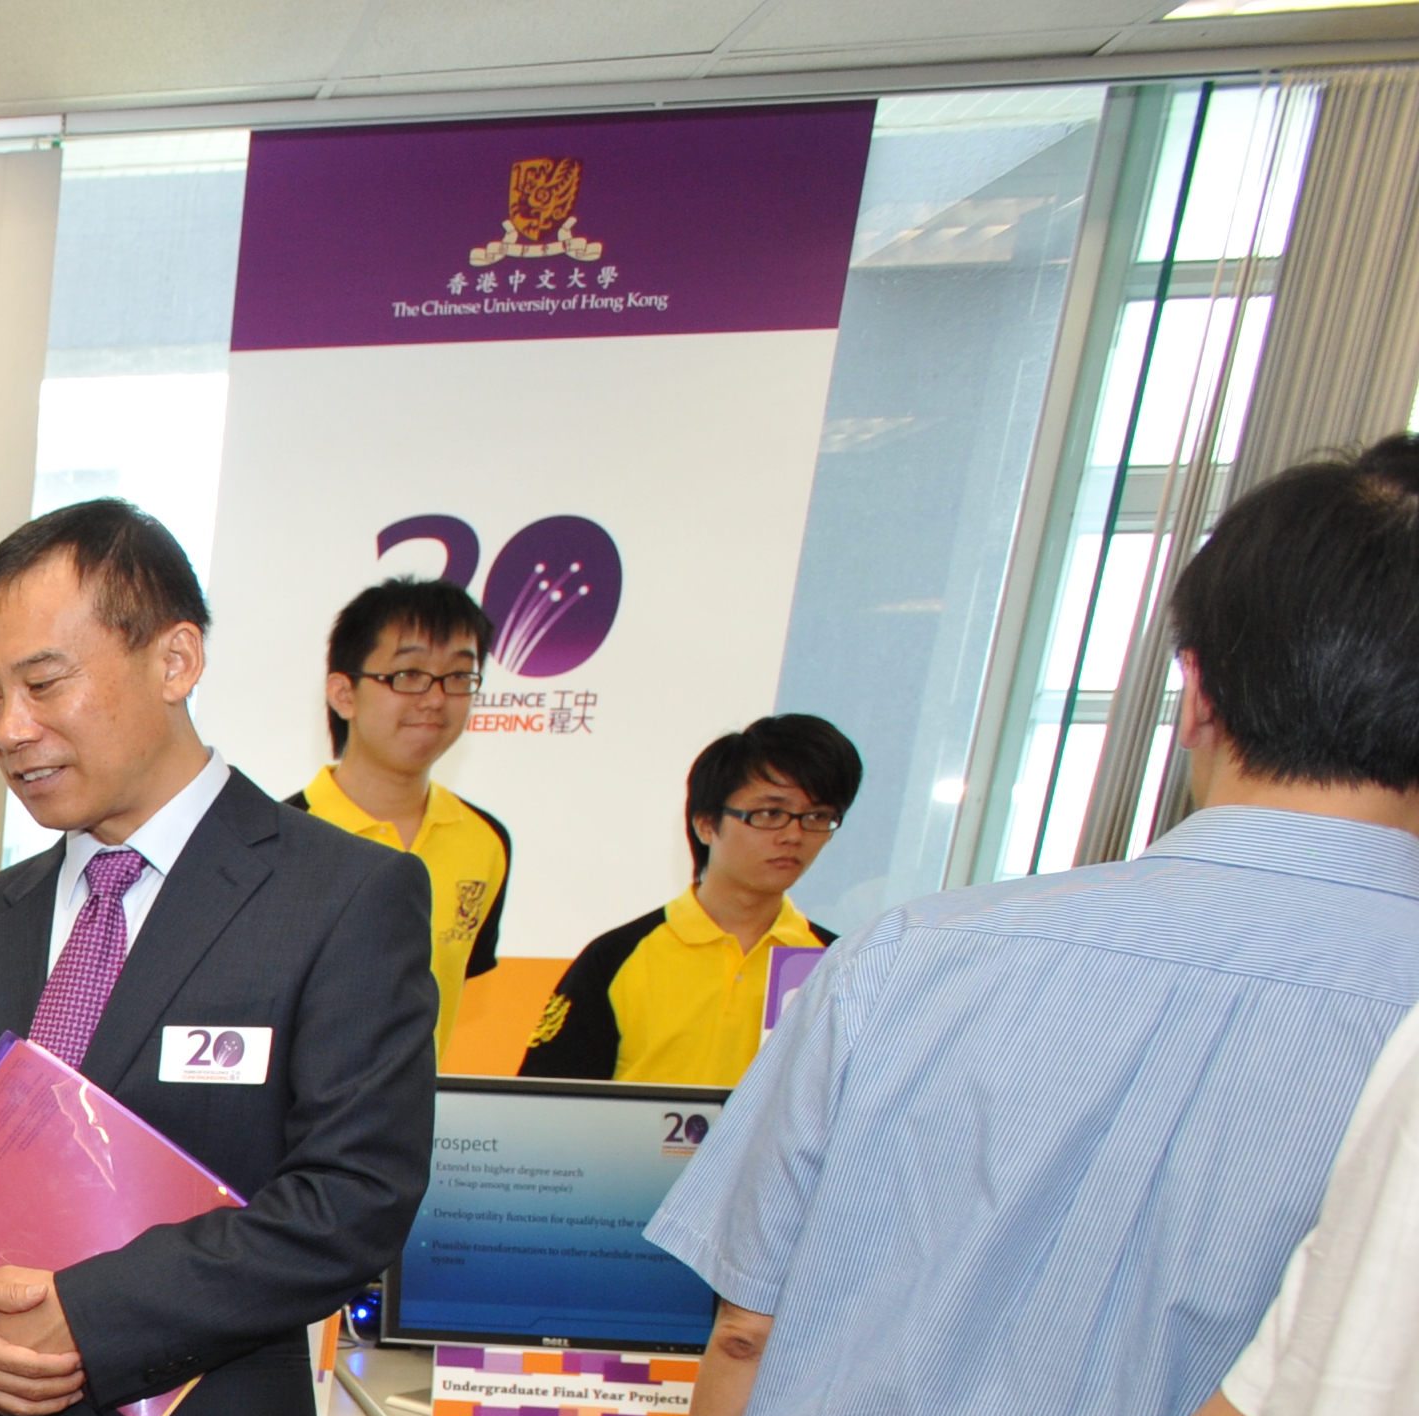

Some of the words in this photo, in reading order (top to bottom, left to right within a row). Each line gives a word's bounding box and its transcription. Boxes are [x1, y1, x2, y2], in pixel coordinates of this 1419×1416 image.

[447, 266, 619, 295] 香港中文大學
[392, 302, 419, 317] The
[421, 299, 482, 316] Chinese
[483, 296, 561, 315] University
[562, 294, 580, 310] of
[580, 294, 623, 313] Hong
[627, 291, 669, 311] Kong
[473, 692, 546, 707] ELLENCE
[185, 1030, 245, 1068] 20
[664, 1112, 709, 1144] 20
[434, 1137, 498, 1154] rospect
[436, 1161, 470, 1173] Extend
[472, 1163, 482, 1173] to
[484, 1163, 515, 1176] higher
[518, 1165, 551, 1177] degree
[553, 1167, 584, 1178] search
[480, 1182, 511, 1192] among
[513, 1183, 537, 1192] more
[434, 1208, 473, 1222] Develop
[475, 1211, 503, 1223] utility
[506, 1212, 548, 1223] function
[550, 1213, 564, 1224] for
[566, 1215, 615, 1229] qualifying
[618, 1217, 634, 1228] the
[542, 1337, 570, 1348] DELL
[442, 1380, 549, 1397] Undergraduate
[552, 1386, 588, 1399] Final
[593, 1388, 624, 1402] Year
[629, 1391, 689, 1406] Projects
